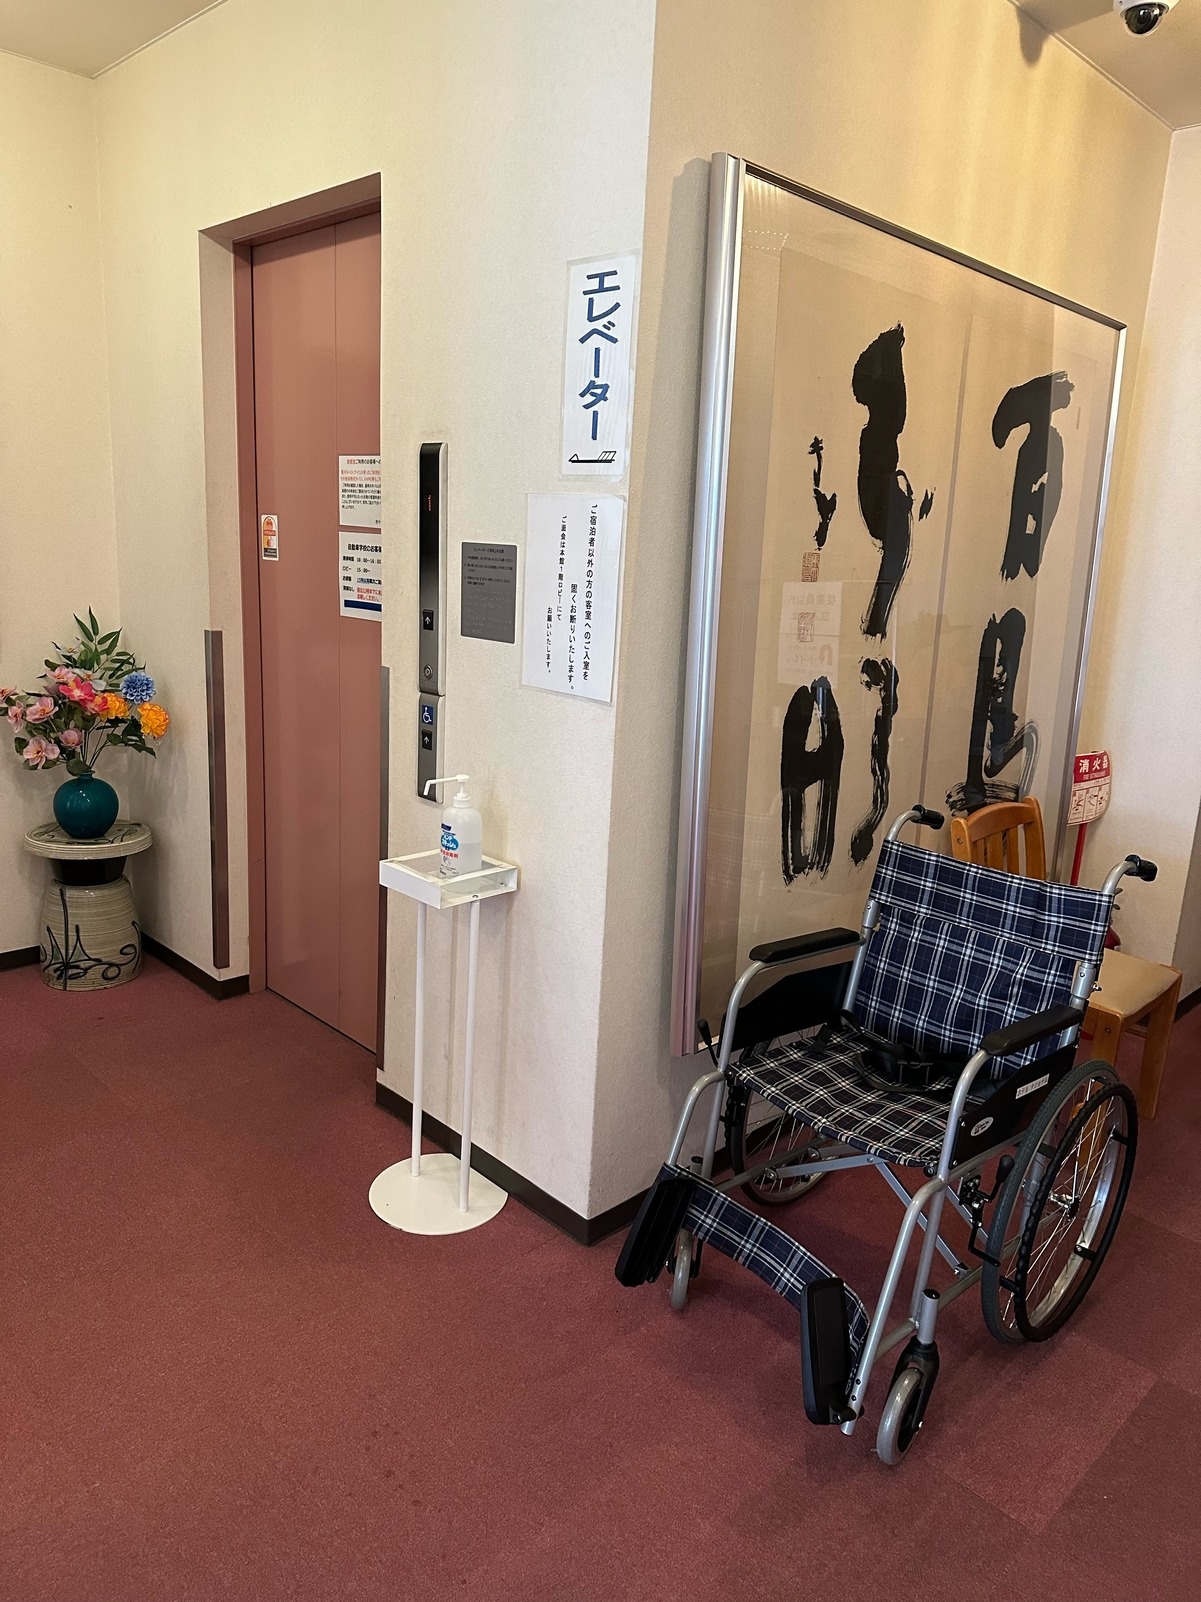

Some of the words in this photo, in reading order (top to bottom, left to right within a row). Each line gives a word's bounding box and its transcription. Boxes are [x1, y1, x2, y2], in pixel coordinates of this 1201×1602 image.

[578, 269, 621, 441] エレベーター
[567, 583, 578, 690] 固くお断りいたします。
[582, 504, 599, 681] ご宿泊者以外の方の客室へのご入室を
[1079, 755, 1109, 774] 消火器
